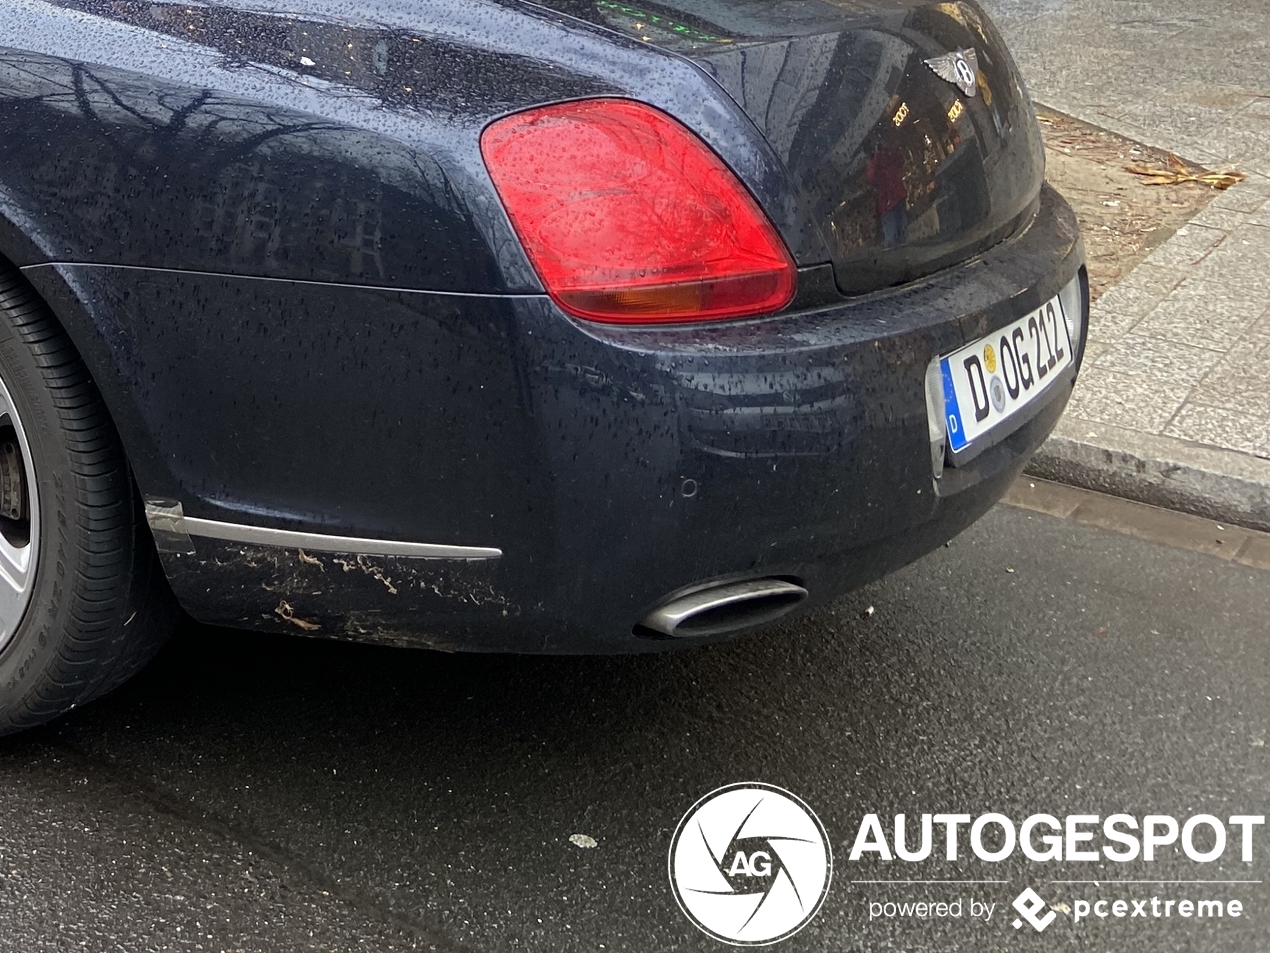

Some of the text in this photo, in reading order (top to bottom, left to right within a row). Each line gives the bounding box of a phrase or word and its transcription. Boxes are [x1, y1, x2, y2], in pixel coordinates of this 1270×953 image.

[963, 301, 1065, 423] D OG 212
[947, 414, 959, 434] D
